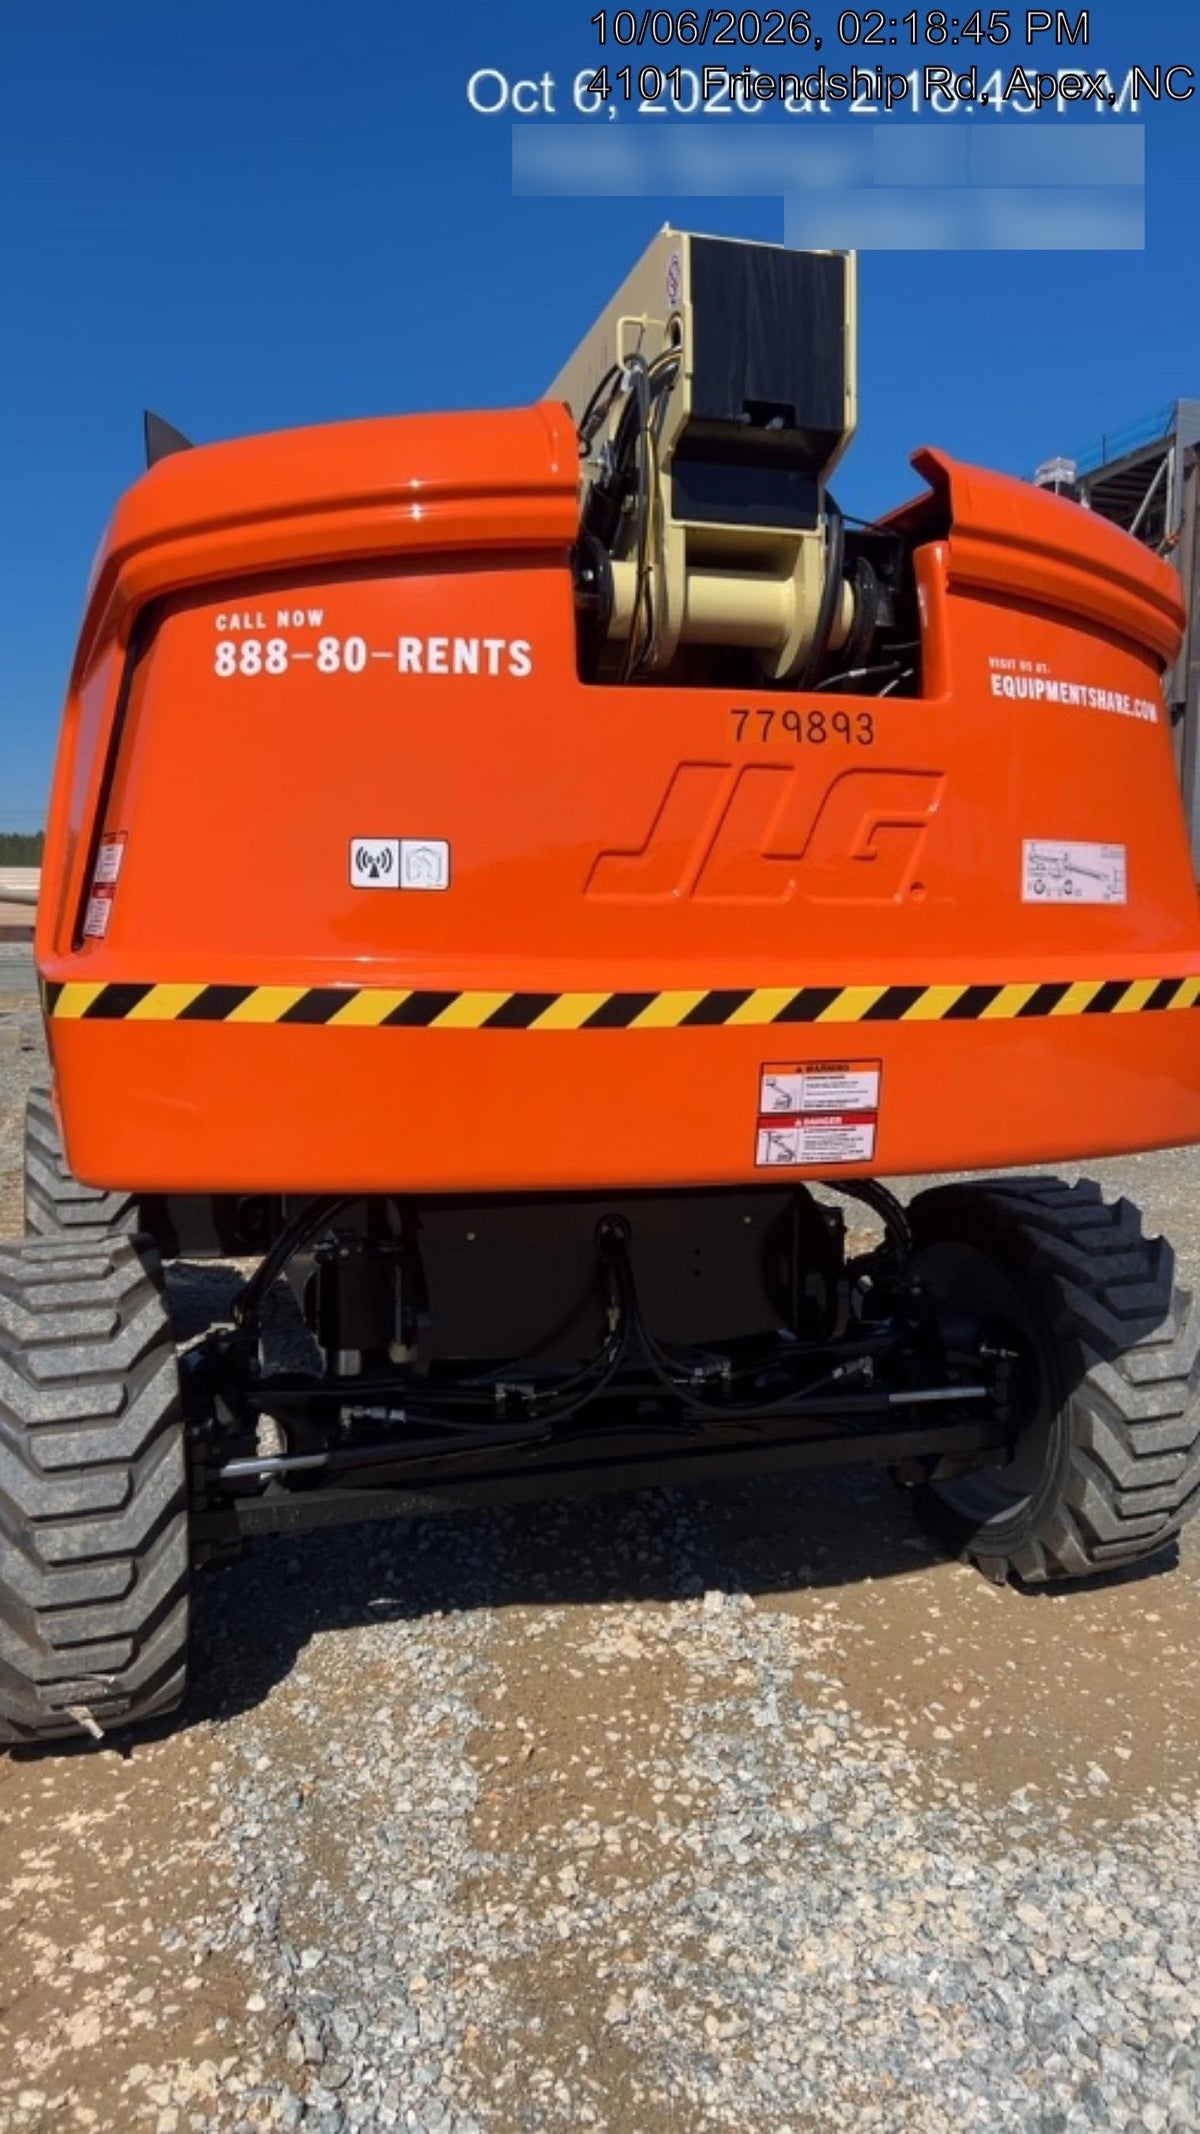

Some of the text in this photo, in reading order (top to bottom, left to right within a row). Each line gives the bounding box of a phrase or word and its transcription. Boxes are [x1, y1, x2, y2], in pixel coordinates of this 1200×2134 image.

[215, 608, 324, 631] CALL NOW
[214, 636, 533, 677] 888-80-RENTS
[988, 657, 1016, 671] VISIT
[990, 673, 1159, 723] EQUIPMENTSHARE.COM
[730, 709, 875, 745] 779893
